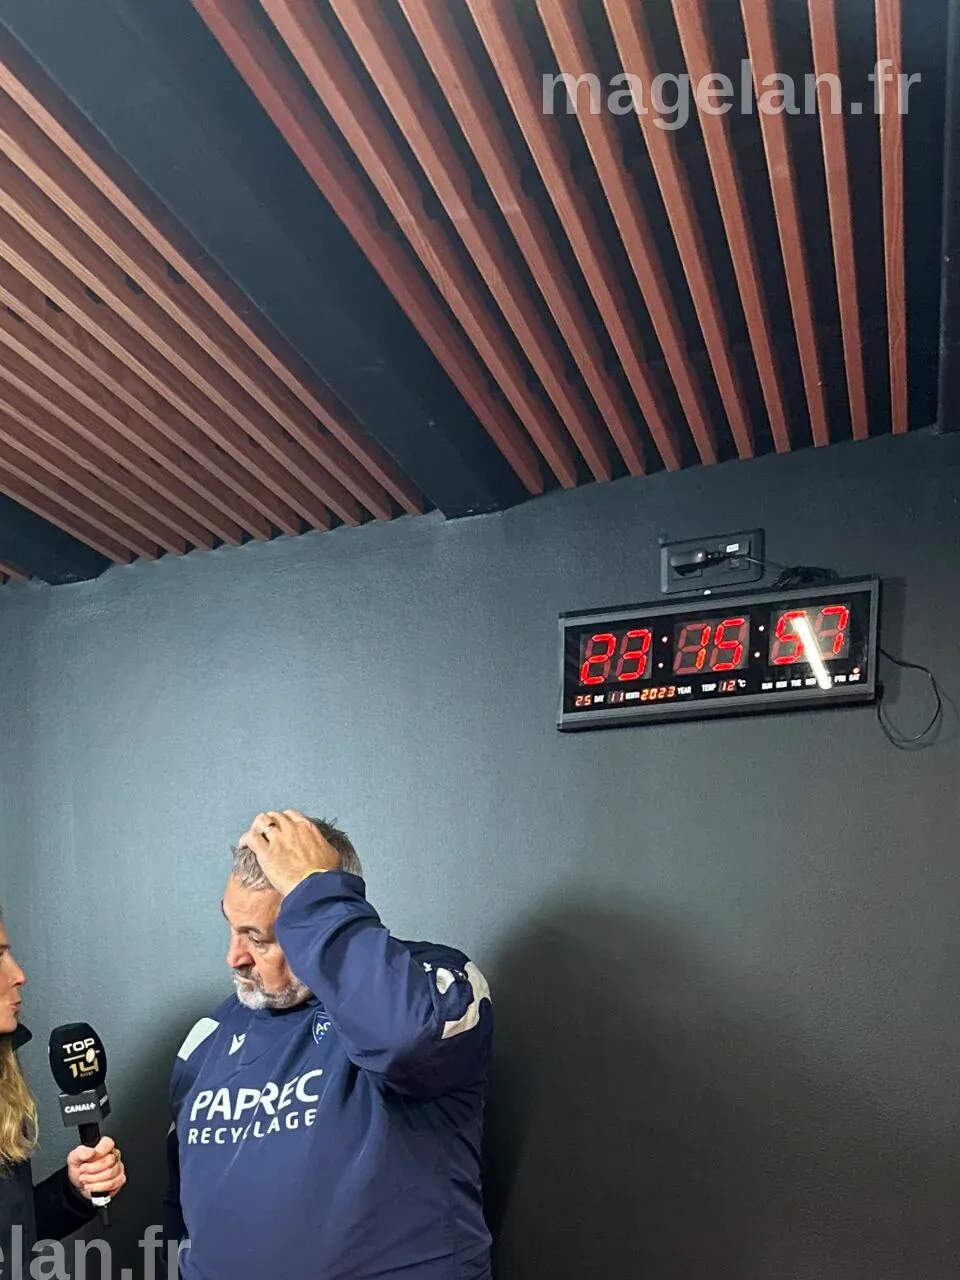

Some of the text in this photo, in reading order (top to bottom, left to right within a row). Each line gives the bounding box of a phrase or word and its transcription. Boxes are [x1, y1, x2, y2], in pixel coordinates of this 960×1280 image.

[640, 686, 676, 701] 2023
[677, 686, 692, 695] YEAR
[701, 683, 717, 692] TEMP
[62, 1037, 95, 1054] TOP
[69, 1057, 100, 1079] 14
[189, 1068, 323, 1122] PAPREC
[64, 1101, 96, 1114] CANAL+
